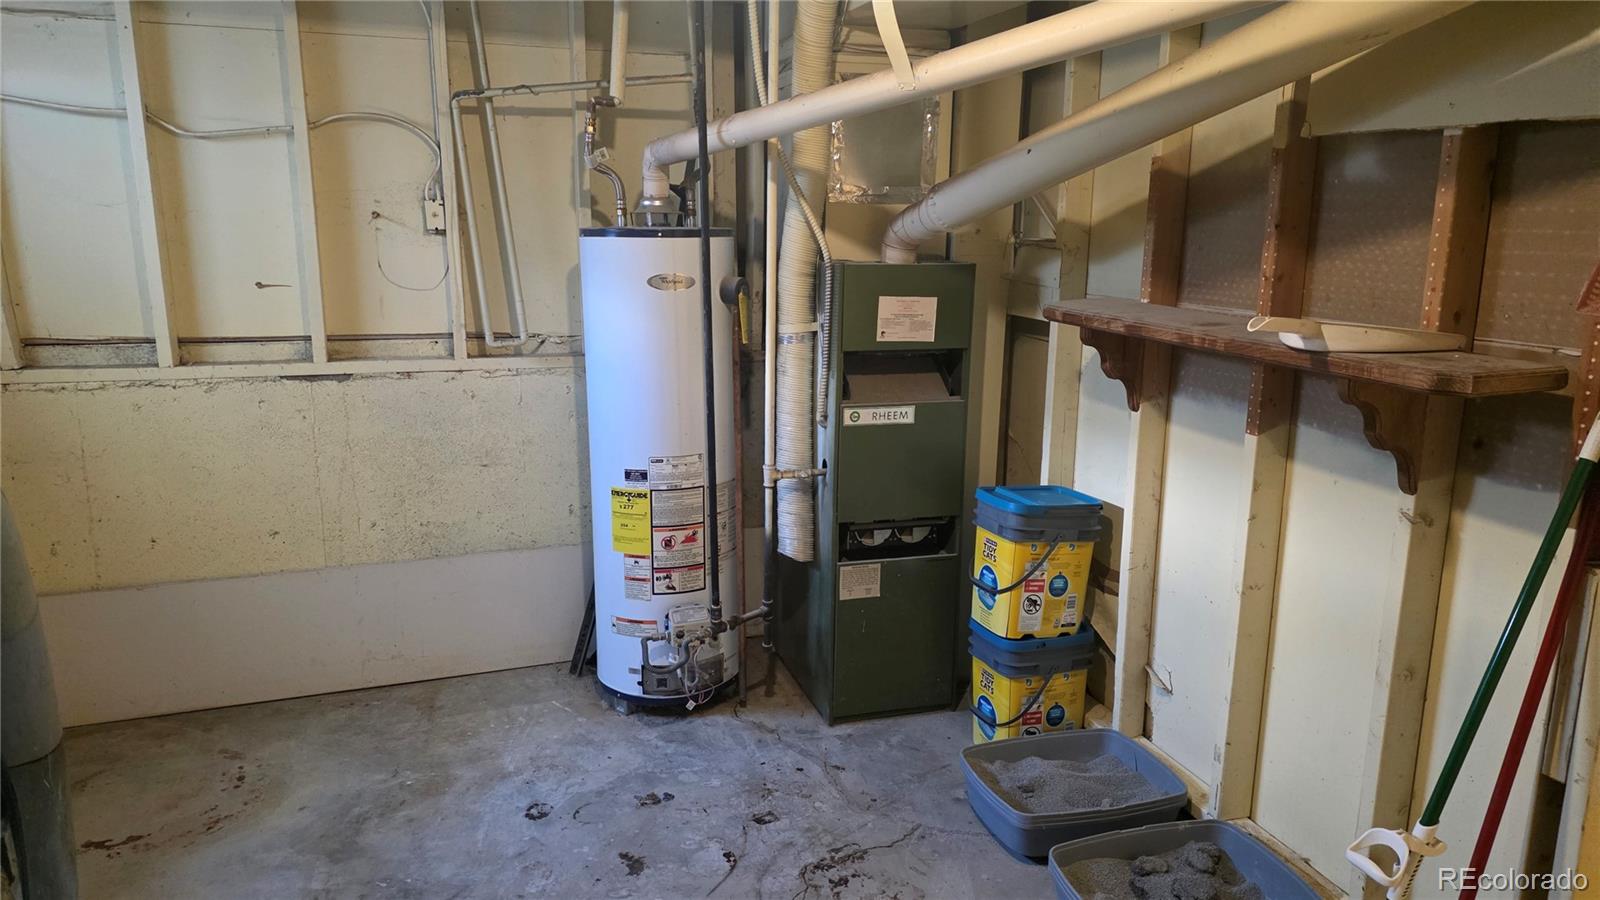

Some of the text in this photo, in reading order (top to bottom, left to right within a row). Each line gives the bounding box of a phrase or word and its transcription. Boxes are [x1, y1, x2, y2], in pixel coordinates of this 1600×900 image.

[872, 411, 909, 421] RHEEM
[983, 543, 997, 555] TIDY
[982, 550, 997, 562] CATS
